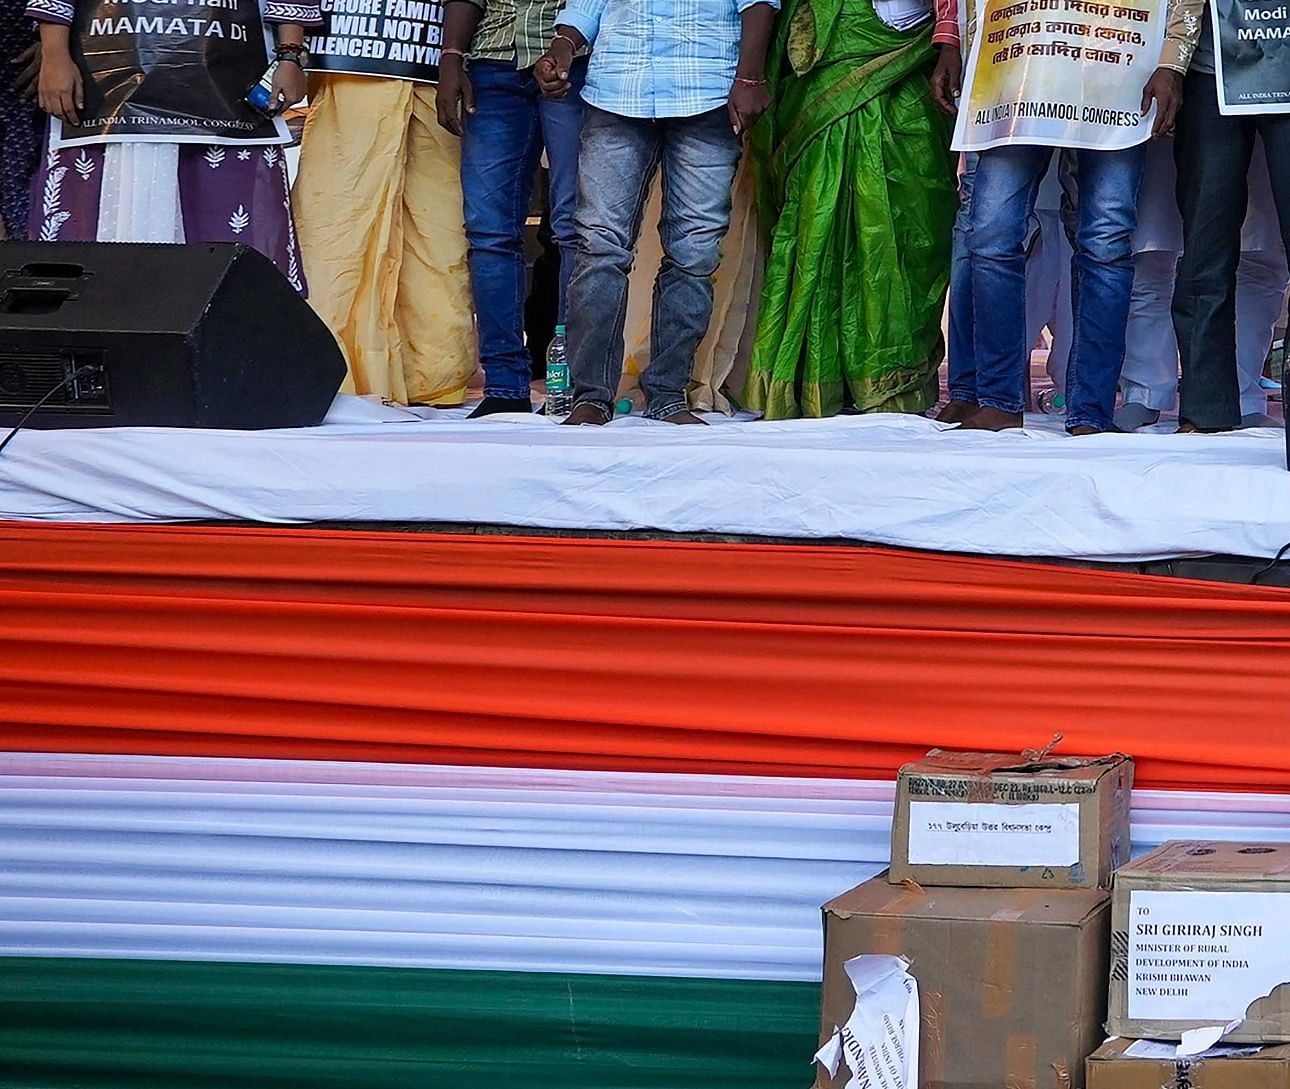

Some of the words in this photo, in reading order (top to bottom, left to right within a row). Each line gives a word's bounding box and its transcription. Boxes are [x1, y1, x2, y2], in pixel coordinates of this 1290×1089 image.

[1030, 0, 1059, 11] ১০০
[1113, 7, 1150, 23] কাজ
[1244, 7, 1286, 21] Modi
[89, 16, 224, 38] MAMATA
[231, 23, 248, 42] Di
[330, 15, 378, 37] WILL
[383, 19, 424, 42] NOT
[1085, 48, 1122, 64] লাজ
[1126, 54, 1134, 66] ?
[975, 110, 990, 125] ALL
[1013, 102, 1079, 121] TRINAMOOL
[1082, 107, 1140, 127] CONGRESS
[81, 117, 96, 129] ALL
[98, 116, 127, 128] INDIA
[131, 116, 201, 128] TRINAMOOL
[203, 118, 255, 131] CONGRESS
[1137, 907, 1150, 915] TO
[1136, 924, 1158, 936] SRI
[1162, 924, 1216, 939] GIRIRAJ
[1219, 925, 1262, 937] SINGH
[1135, 944, 1181, 953] MINISTER
[1183, 944, 1197, 953] OF
[1198, 944, 1230, 953] RURAL
[1135, 958, 1205, 968] DEVELOPMENT
[1207, 959, 1221, 968] OF
[1222, 960, 1249, 969] INDIA
[1135, 973, 1167, 982] KRISHI
[1170, 973, 1212, 983] BHAWAN
[1135, 987, 1158, 996] NEW
[1160, 988, 1189, 997] DELHI
